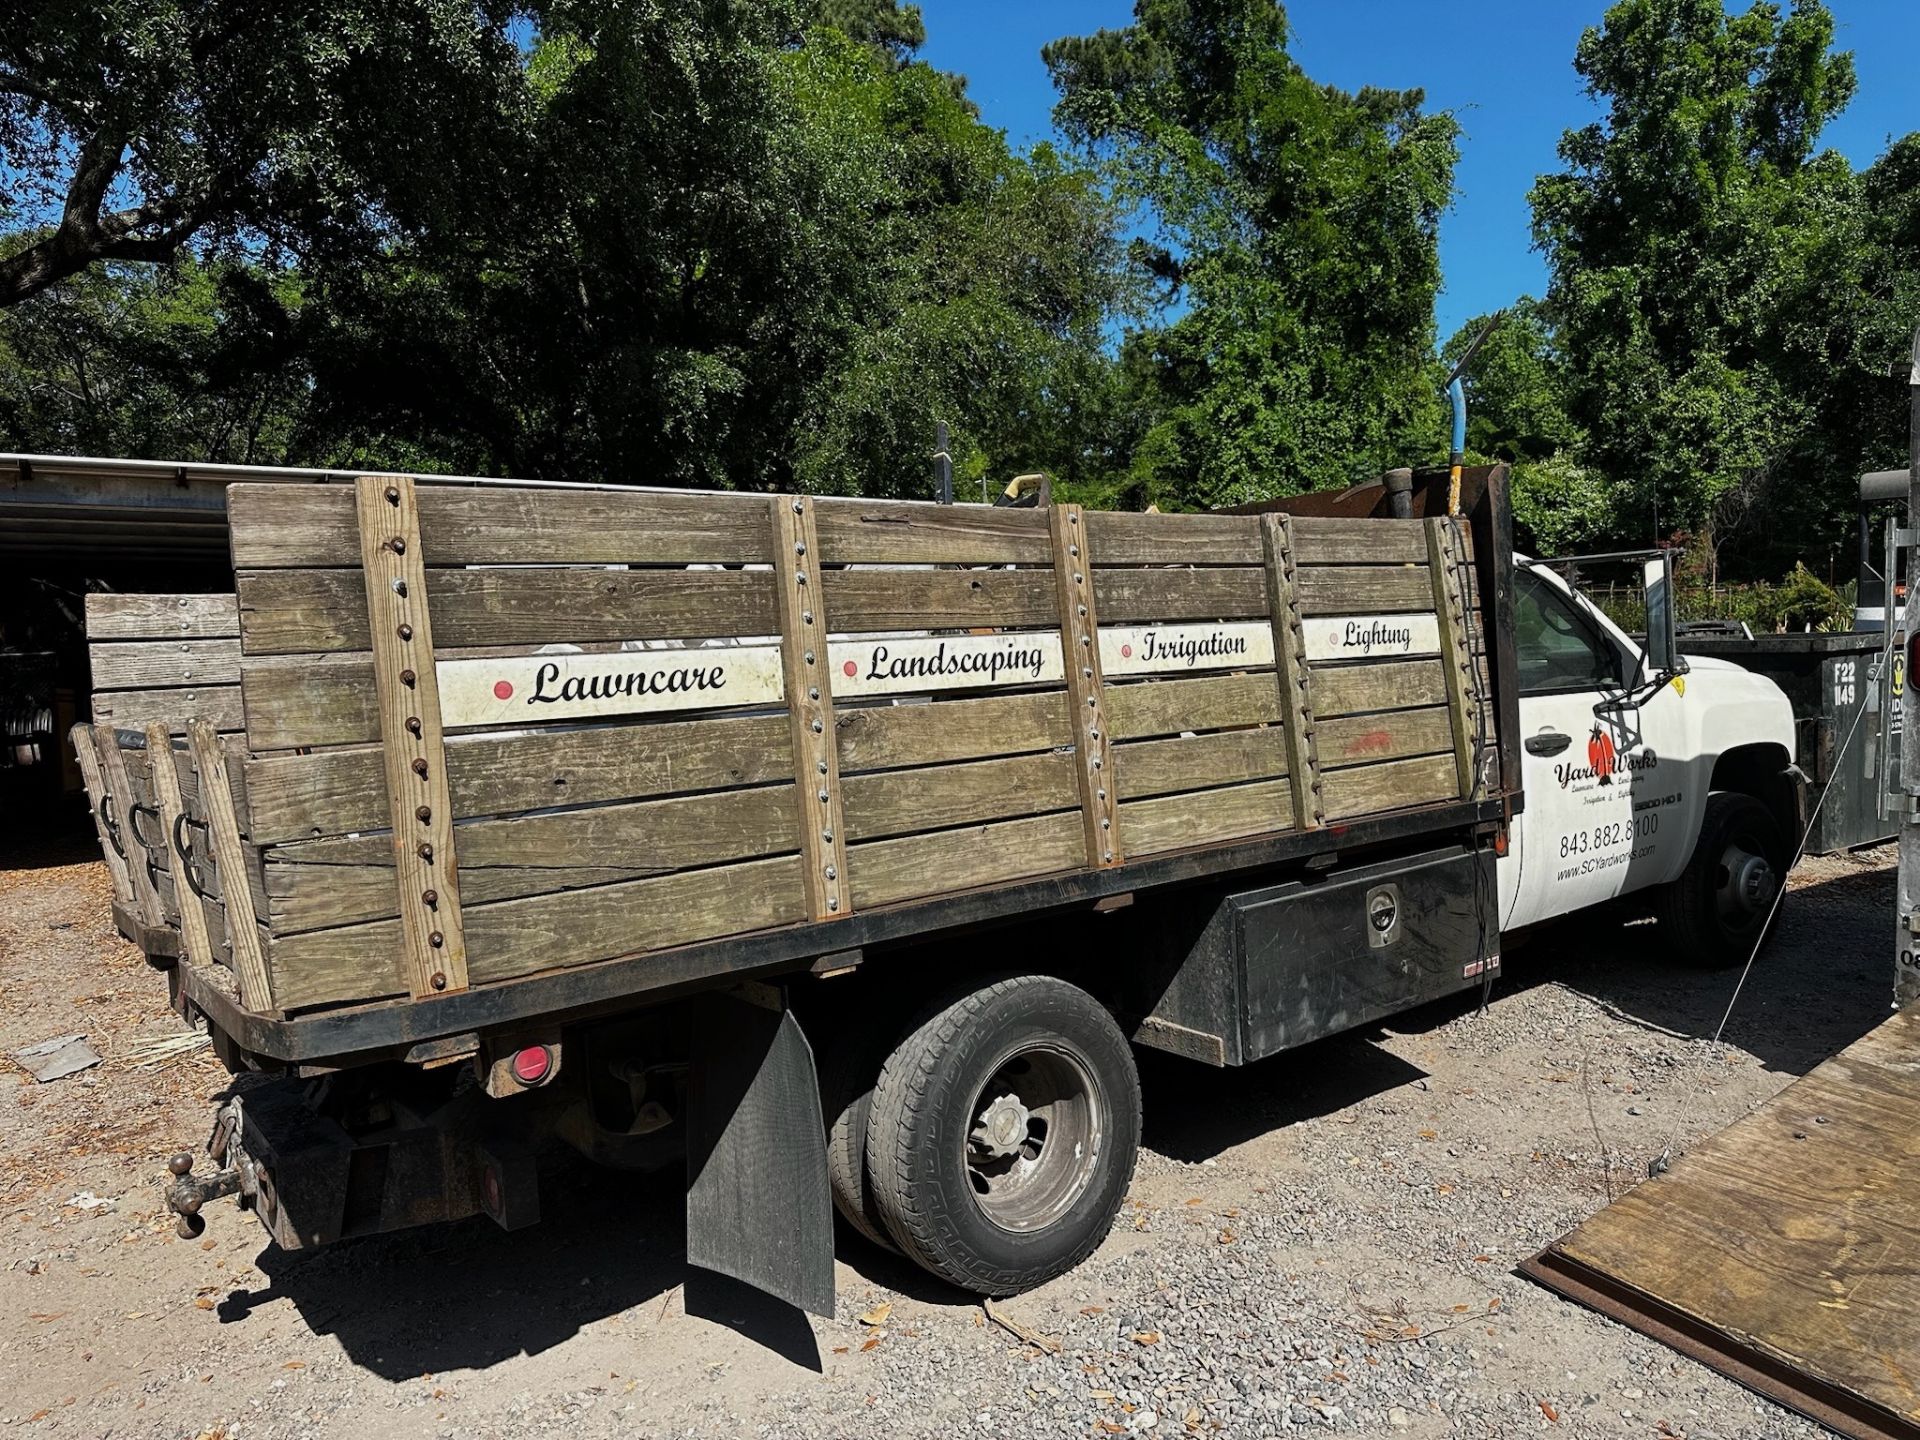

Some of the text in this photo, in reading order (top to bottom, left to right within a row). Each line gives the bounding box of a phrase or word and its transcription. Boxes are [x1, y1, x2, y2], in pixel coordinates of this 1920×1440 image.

[1141, 631, 1248, 667] Irrigation
[1342, 621, 1412, 656] Lighting
[526, 660, 728, 706] Lawncare
[865, 642, 1046, 687] Landscaping
[1834, 661, 1856, 683] F22
[1554, 750, 1658, 790] Yard Works
[1560, 813, 1659, 858] 843.882.8100
[1557, 844, 1656, 882] www.SCYardworks.com
